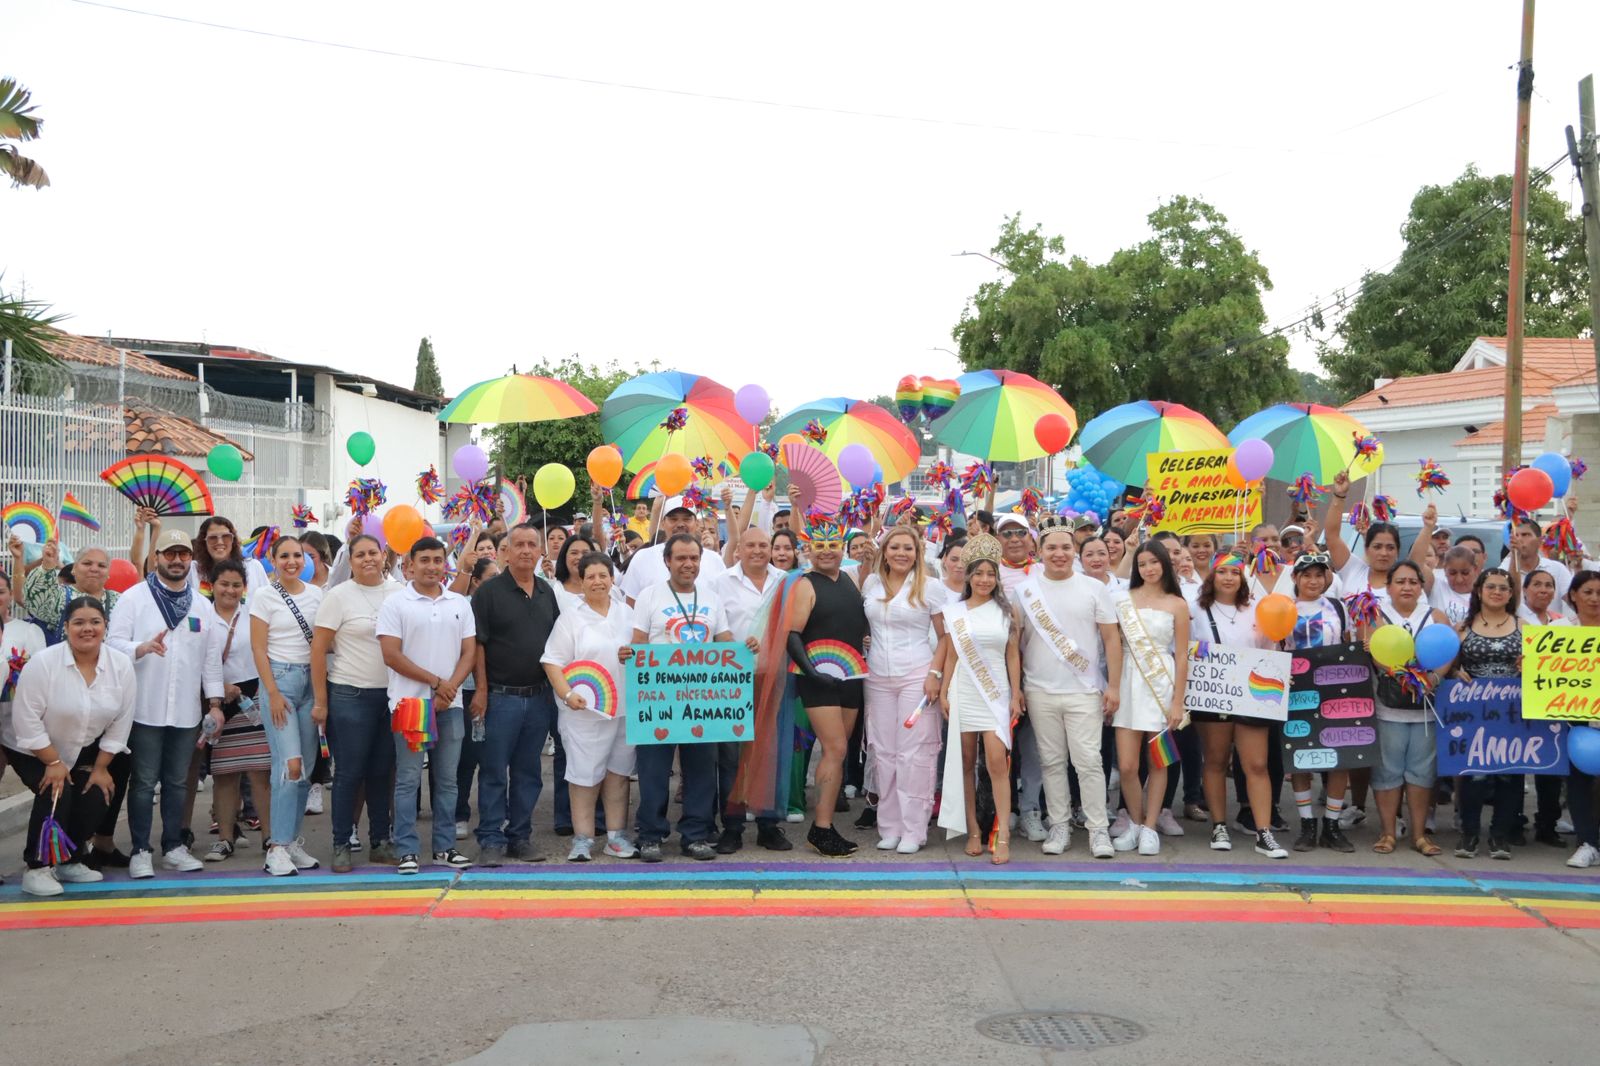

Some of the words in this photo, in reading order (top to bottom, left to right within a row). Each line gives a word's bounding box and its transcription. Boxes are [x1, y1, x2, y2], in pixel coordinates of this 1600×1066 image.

[1160, 477, 1179, 490] EL
[1169, 488, 1252, 505] DIVERSIDAD
[1536, 630, 1600, 653] CELE
[635, 650, 660, 668] EL
[668, 648, 743, 670] AMOR
[1537, 655, 1600, 672] TODOS
[638, 671, 650, 684] ES
[656, 672, 708, 684] DEMASIADO
[711, 671, 751, 684] GRANDE
[1192, 665, 1206, 678] ES
[1211, 667, 1227, 680] DE
[1315, 666, 1368, 682] BISEXUAL
[638, 690, 666, 702] PARA
[676, 687, 742, 701] ENCERRARLO
[1187, 680, 1223, 694] TODOS
[1225, 684, 1243, 697] LOS
[1449, 681, 1522, 703] Celebrem
[1184, 695, 1233, 711] COLORES
[1322, 700, 1372, 715] EXISTEN
[639, 706, 652, 723] EN
[659, 705, 673, 720] UN
[1286, 722, 1309, 735] LAS
[1467, 726, 1544, 767] AMOR
[1295, 752, 1305, 765] Y
